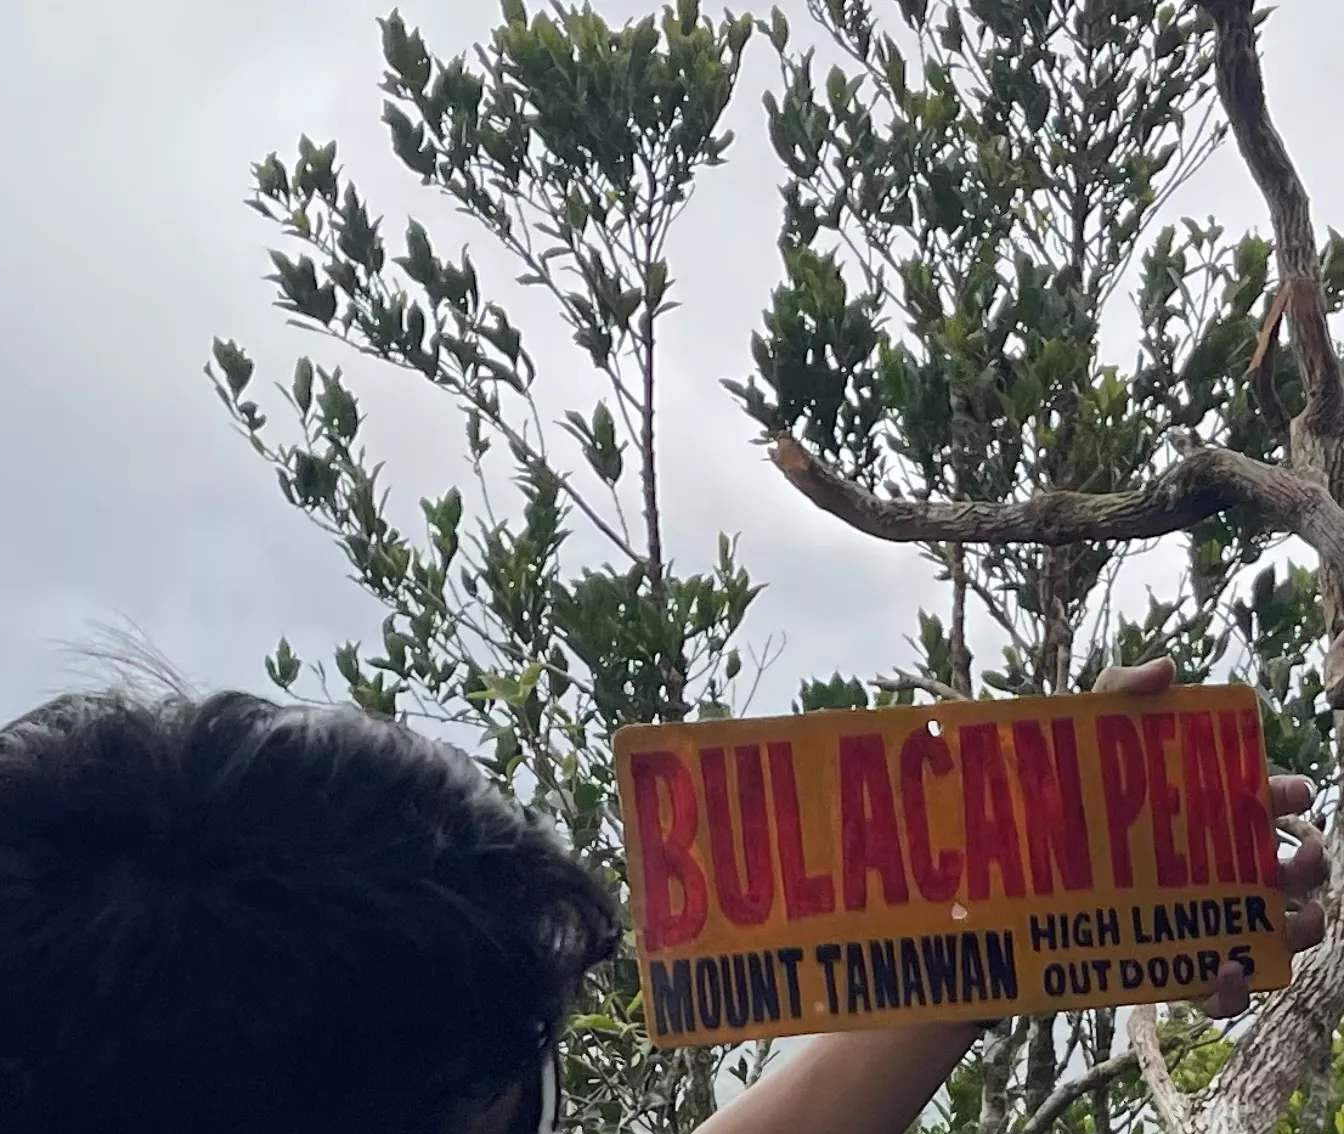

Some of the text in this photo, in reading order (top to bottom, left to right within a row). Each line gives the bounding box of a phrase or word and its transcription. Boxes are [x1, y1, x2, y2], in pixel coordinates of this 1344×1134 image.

[630, 708, 1279, 950] BULACAN PEAK
[1029, 895, 1275, 951] HIGH LANDER
[649, 929, 1018, 1036] MOUNT TANAWAN
